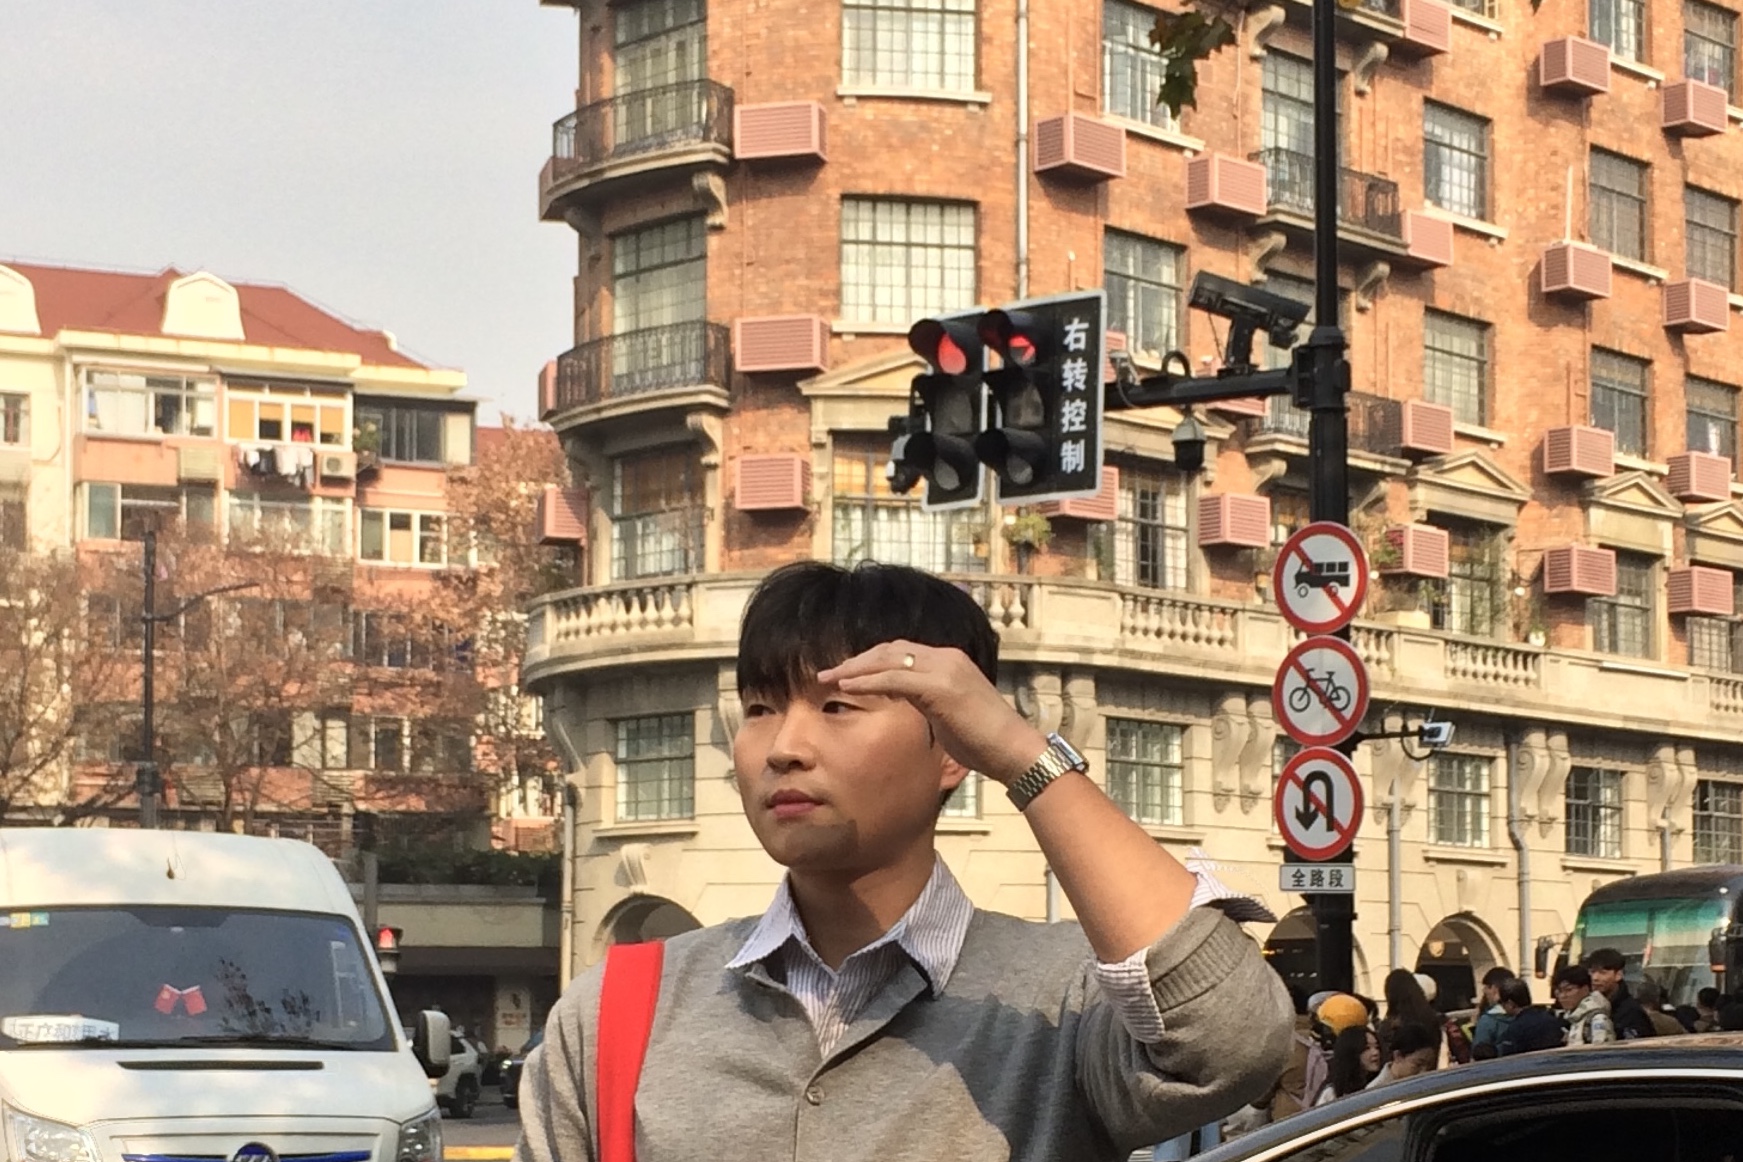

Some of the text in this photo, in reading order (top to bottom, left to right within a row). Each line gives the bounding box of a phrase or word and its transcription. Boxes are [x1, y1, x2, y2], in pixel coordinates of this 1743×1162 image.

[1060, 317, 1090, 475] 右转控制
[1291, 867, 1344, 888] 全路段
